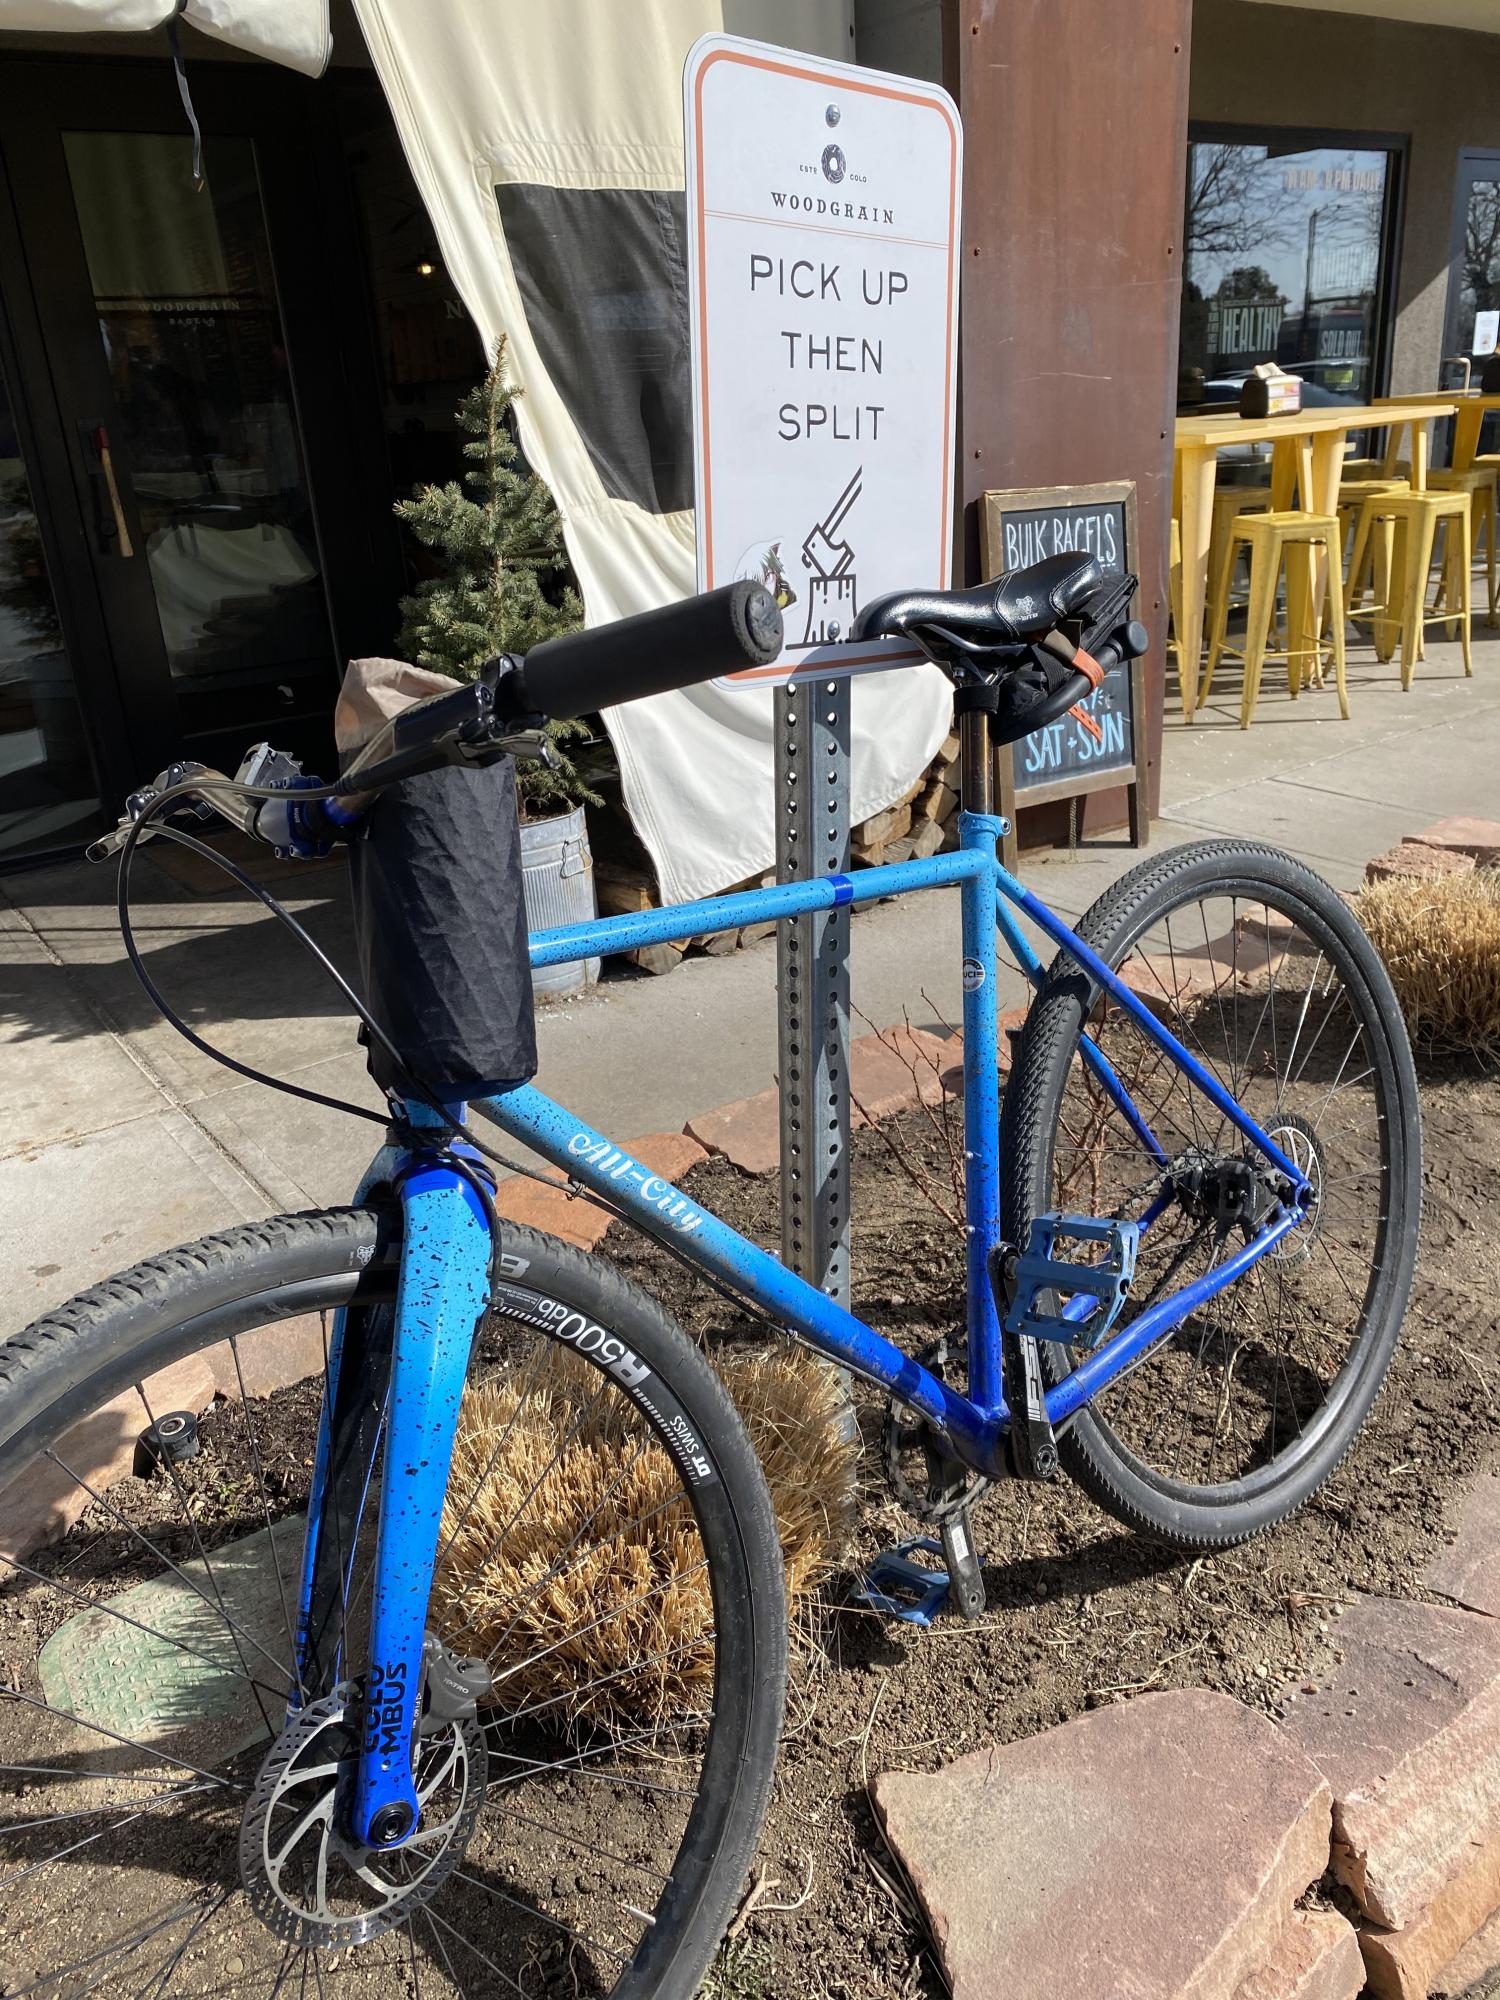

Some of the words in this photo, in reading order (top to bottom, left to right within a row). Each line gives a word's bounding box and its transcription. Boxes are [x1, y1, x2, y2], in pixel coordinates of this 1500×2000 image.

[849, 174, 868, 183] COLO
[770, 191, 894, 224] WOODGRAIN
[750, 254, 841, 301] PICK
[862, 269, 908, 305] UP
[138, 300, 240, 312] WOODGRAIN
[1222, 306, 1282, 354] HEALTHY
[1320, 330, 1344, 357] SOLD
[781, 331, 883, 374] THEN
[778, 403, 885, 441] SPLIT
[1026, 724, 1065, 772] SAT
[1077, 711, 1125, 760] SUN
[568, 1133, 703, 1233] All-City
[669, 1415, 701, 1454] SWISS
[692, 1456, 712, 1478] DT
